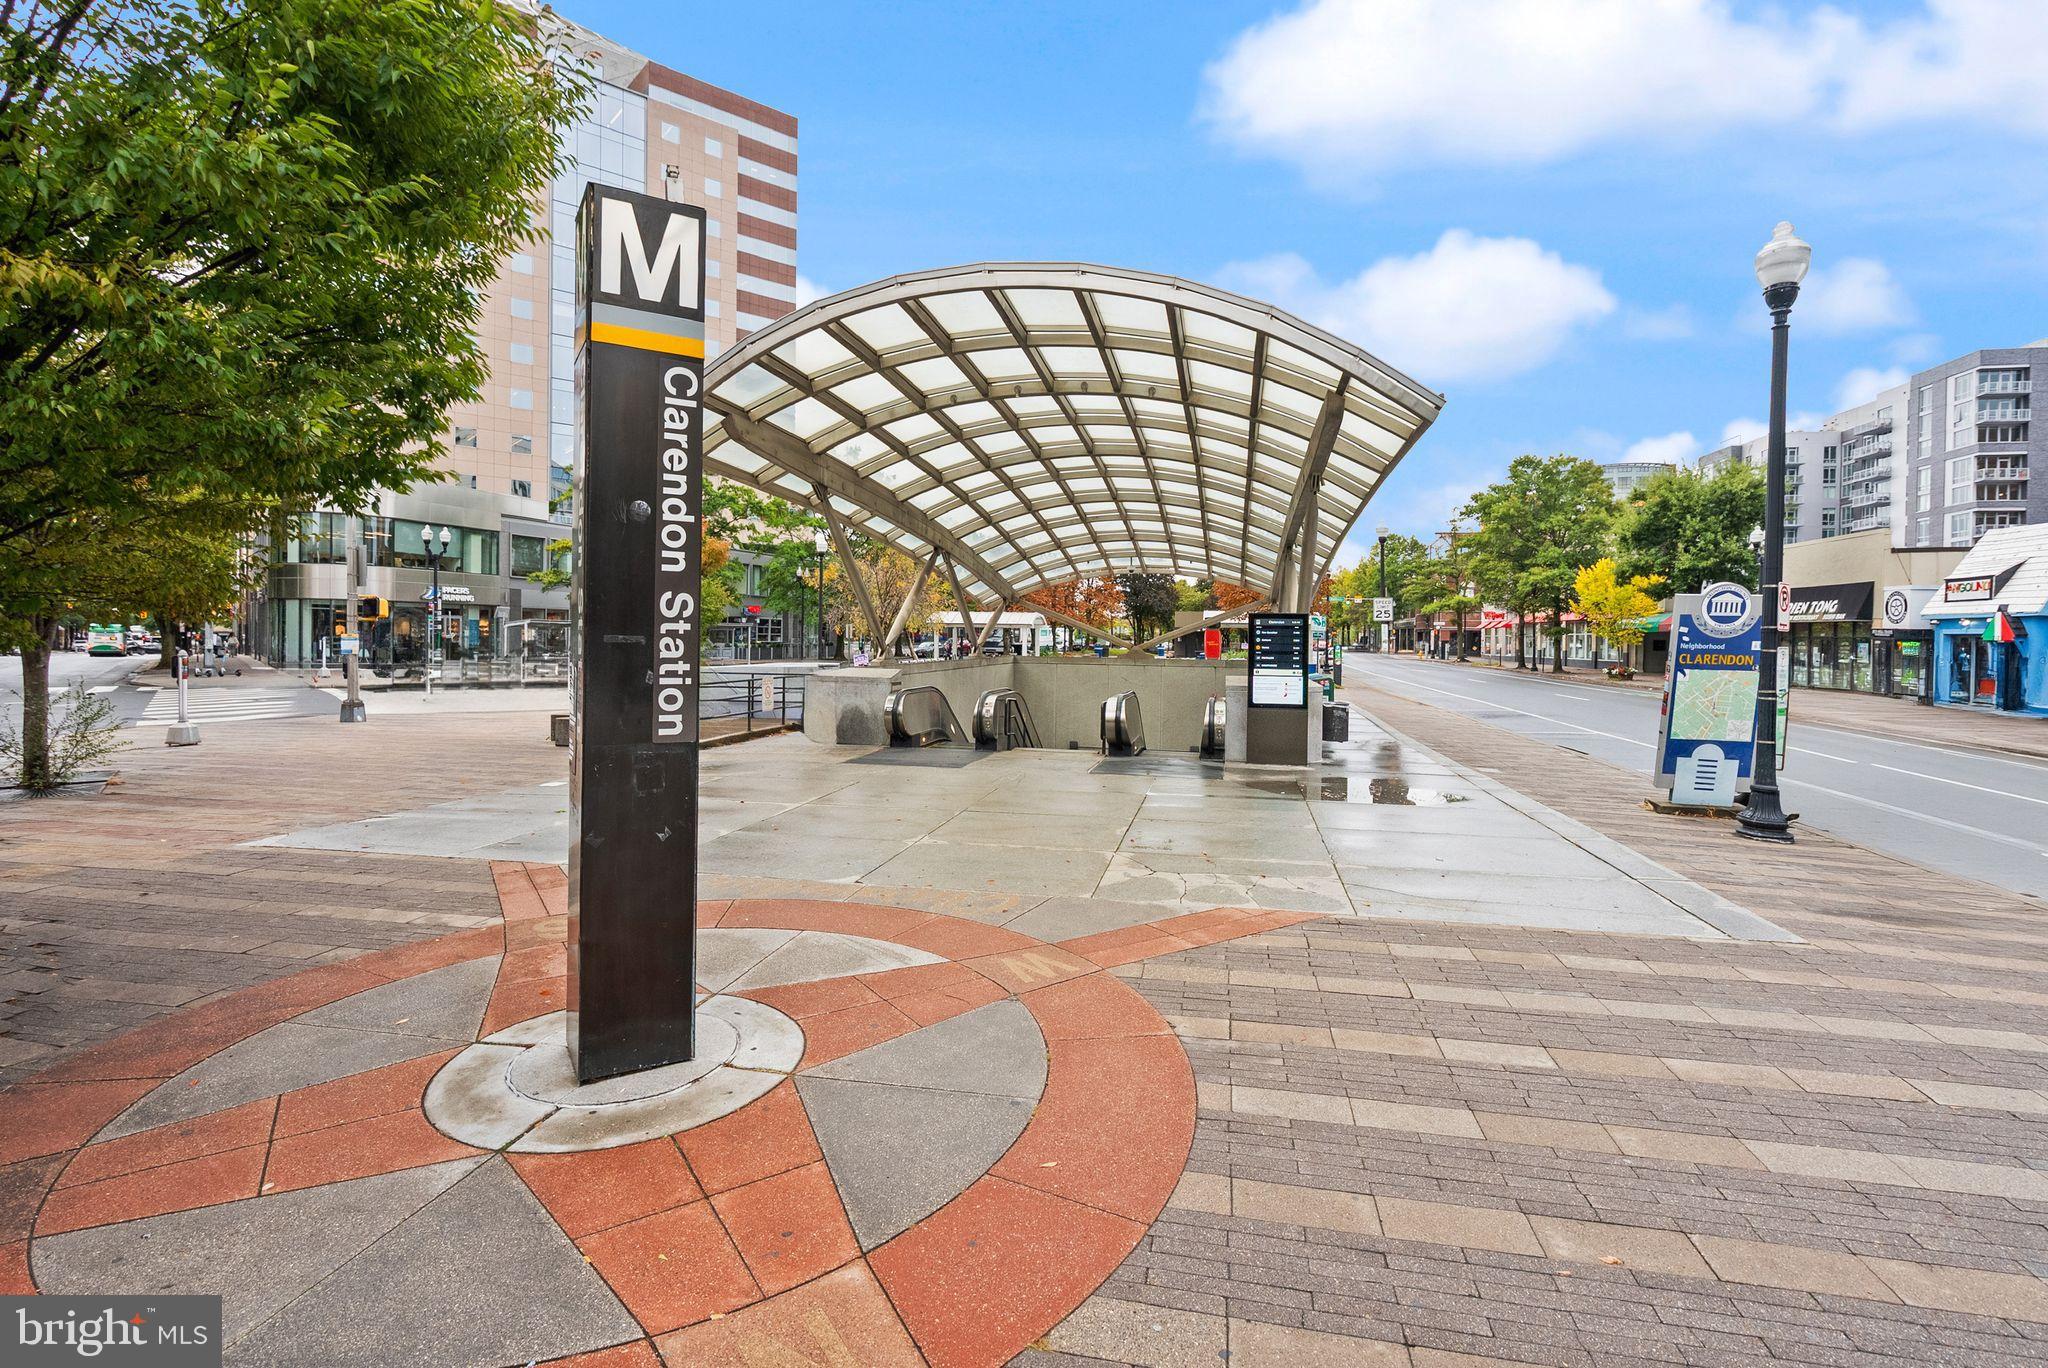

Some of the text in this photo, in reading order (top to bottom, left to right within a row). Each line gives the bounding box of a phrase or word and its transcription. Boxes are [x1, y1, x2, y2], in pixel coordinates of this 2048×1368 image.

[600, 196, 700, 310] M
[658, 366, 699, 736] Clarendon Station
[442, 586, 470, 595] PACERS
[442, 594, 475, 602] RUNNING
[1809, 599, 1839, 613] TONG
[1375, 609, 1391, 619] 25
[1680, 642, 1726, 650] Neighborhood
[1679, 653, 1754, 666] CLARENDON
